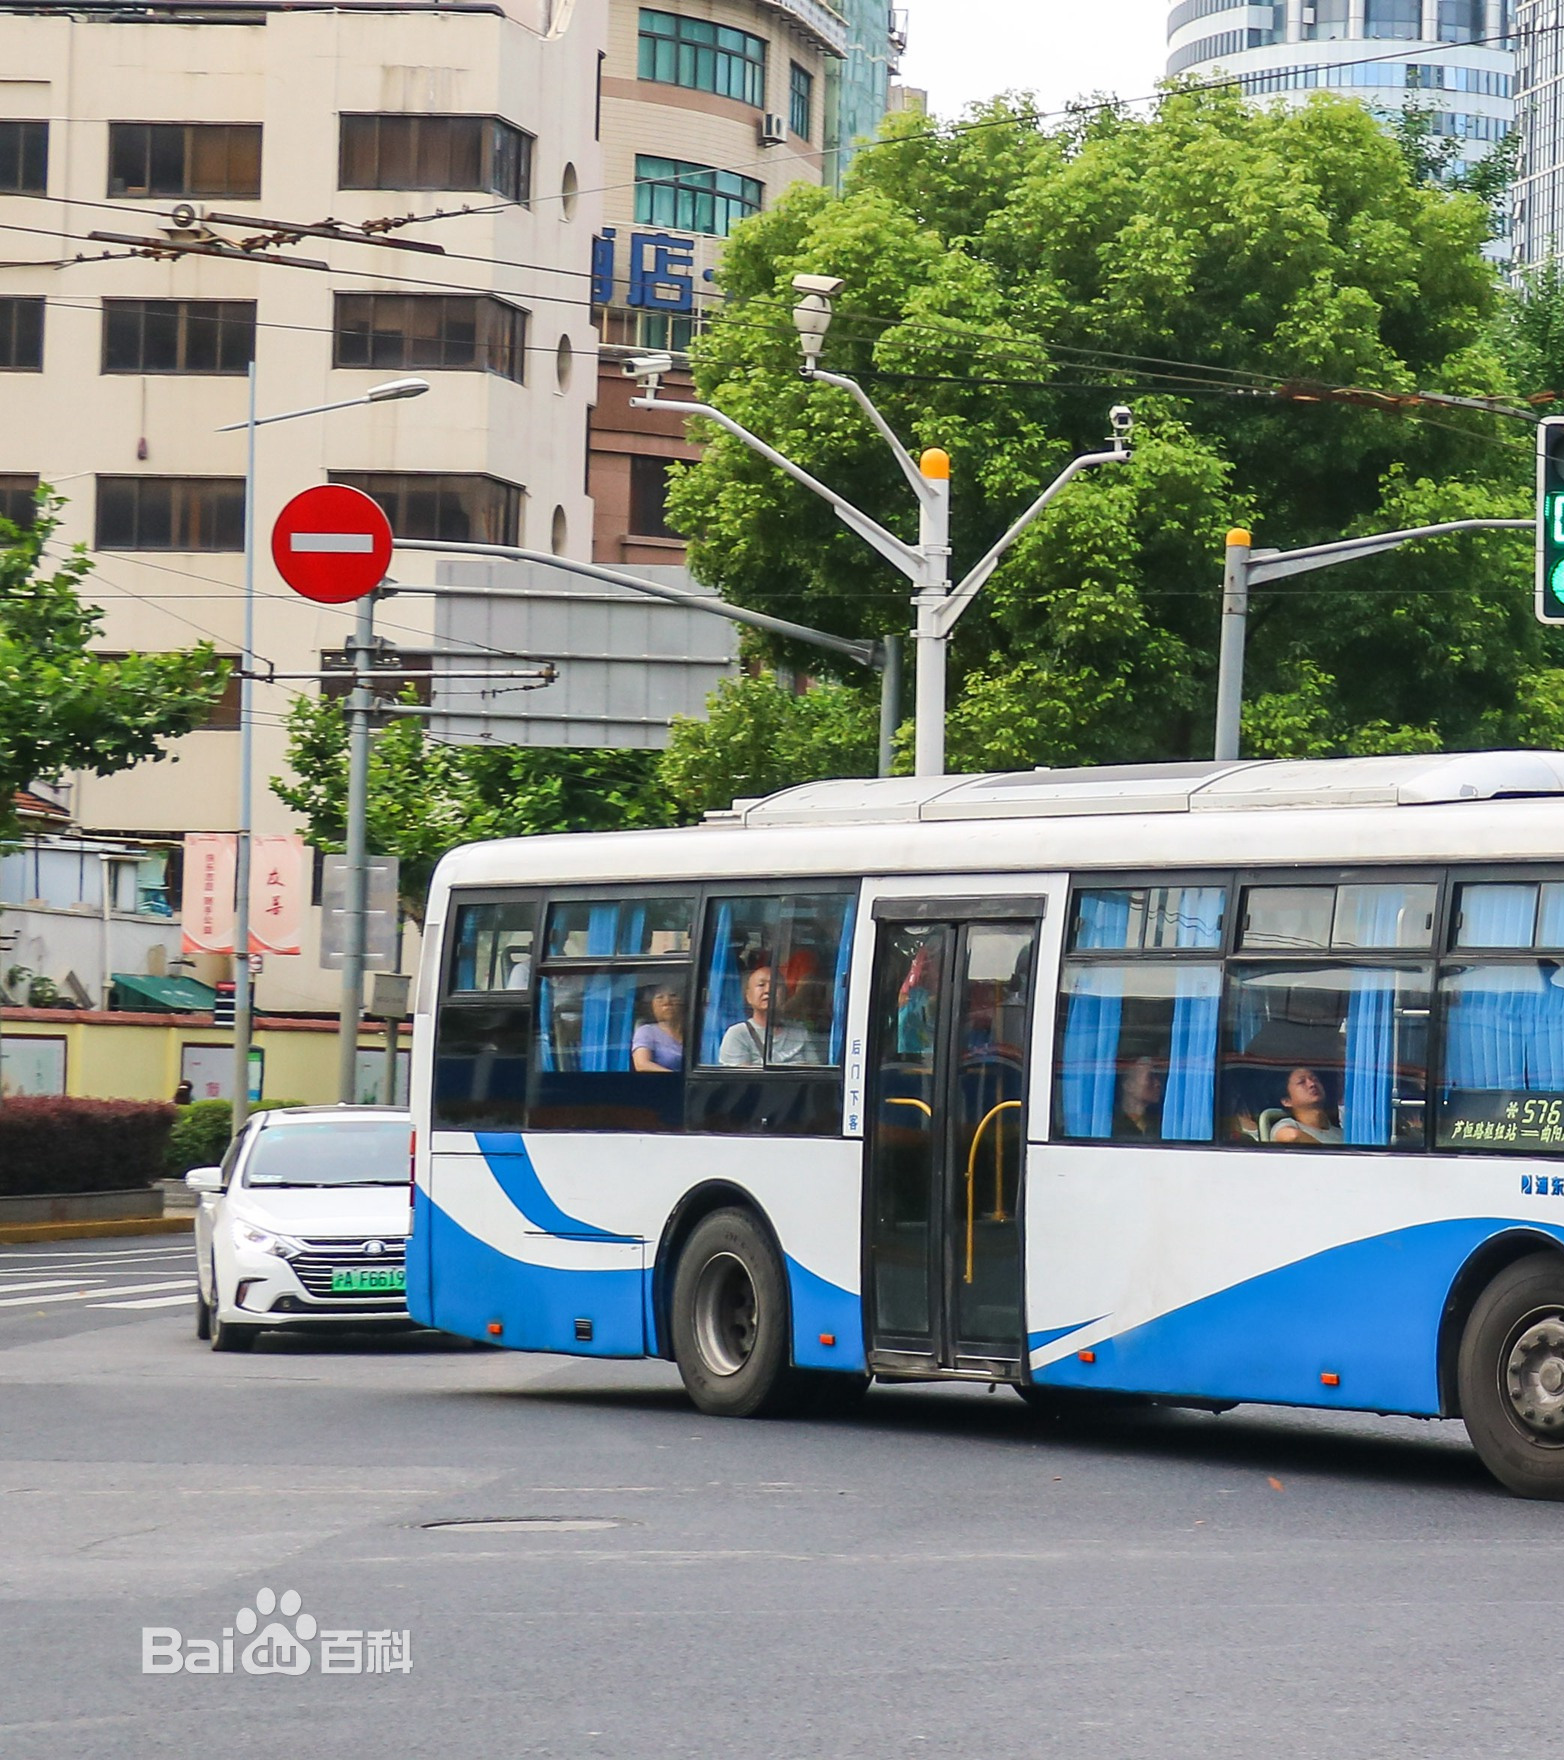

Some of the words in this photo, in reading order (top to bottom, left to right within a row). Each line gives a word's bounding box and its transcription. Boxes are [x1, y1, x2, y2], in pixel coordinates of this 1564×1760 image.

[849, 1039, 862, 1131] 后门下客
[1521, 1099, 1563, 1125] 576
